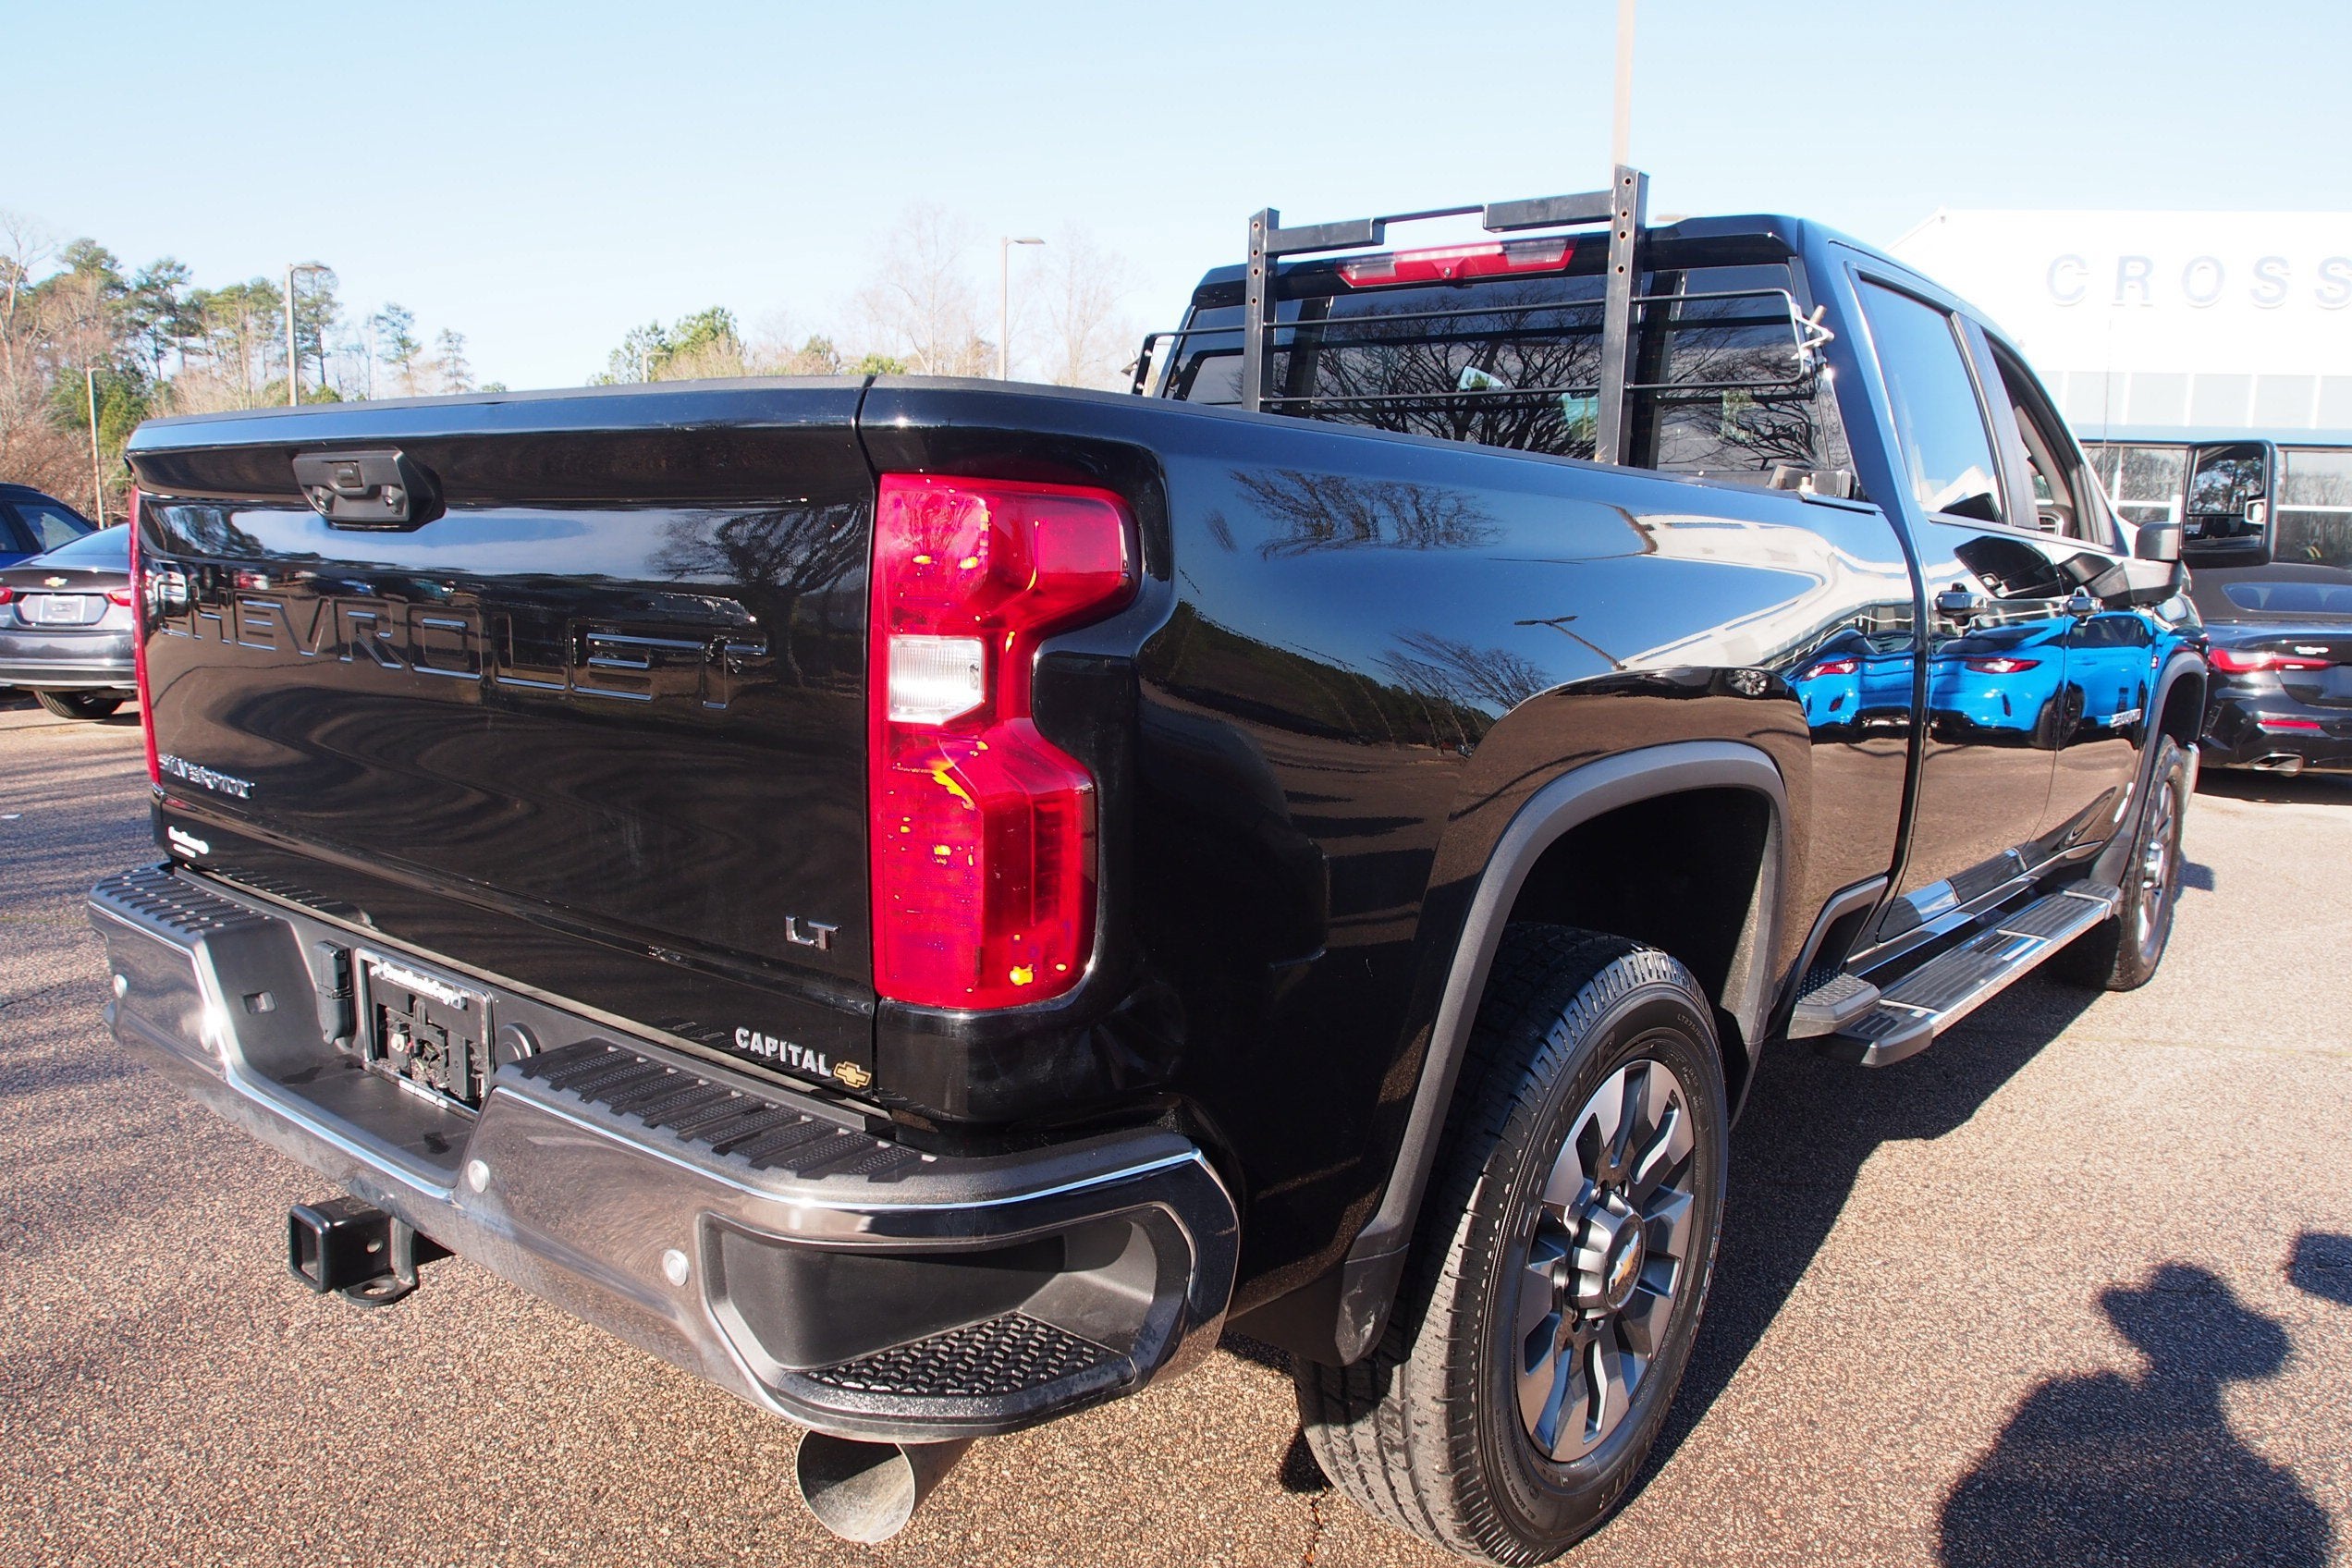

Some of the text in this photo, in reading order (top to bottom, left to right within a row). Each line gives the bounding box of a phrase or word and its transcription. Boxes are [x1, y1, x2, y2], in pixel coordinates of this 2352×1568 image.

[2046, 252, 2352, 311] CROSS
[157, 578, 768, 710] CHEVROLET
[786, 915, 842, 950] LT
[735, 1026, 832, 1078] CAPITAL
